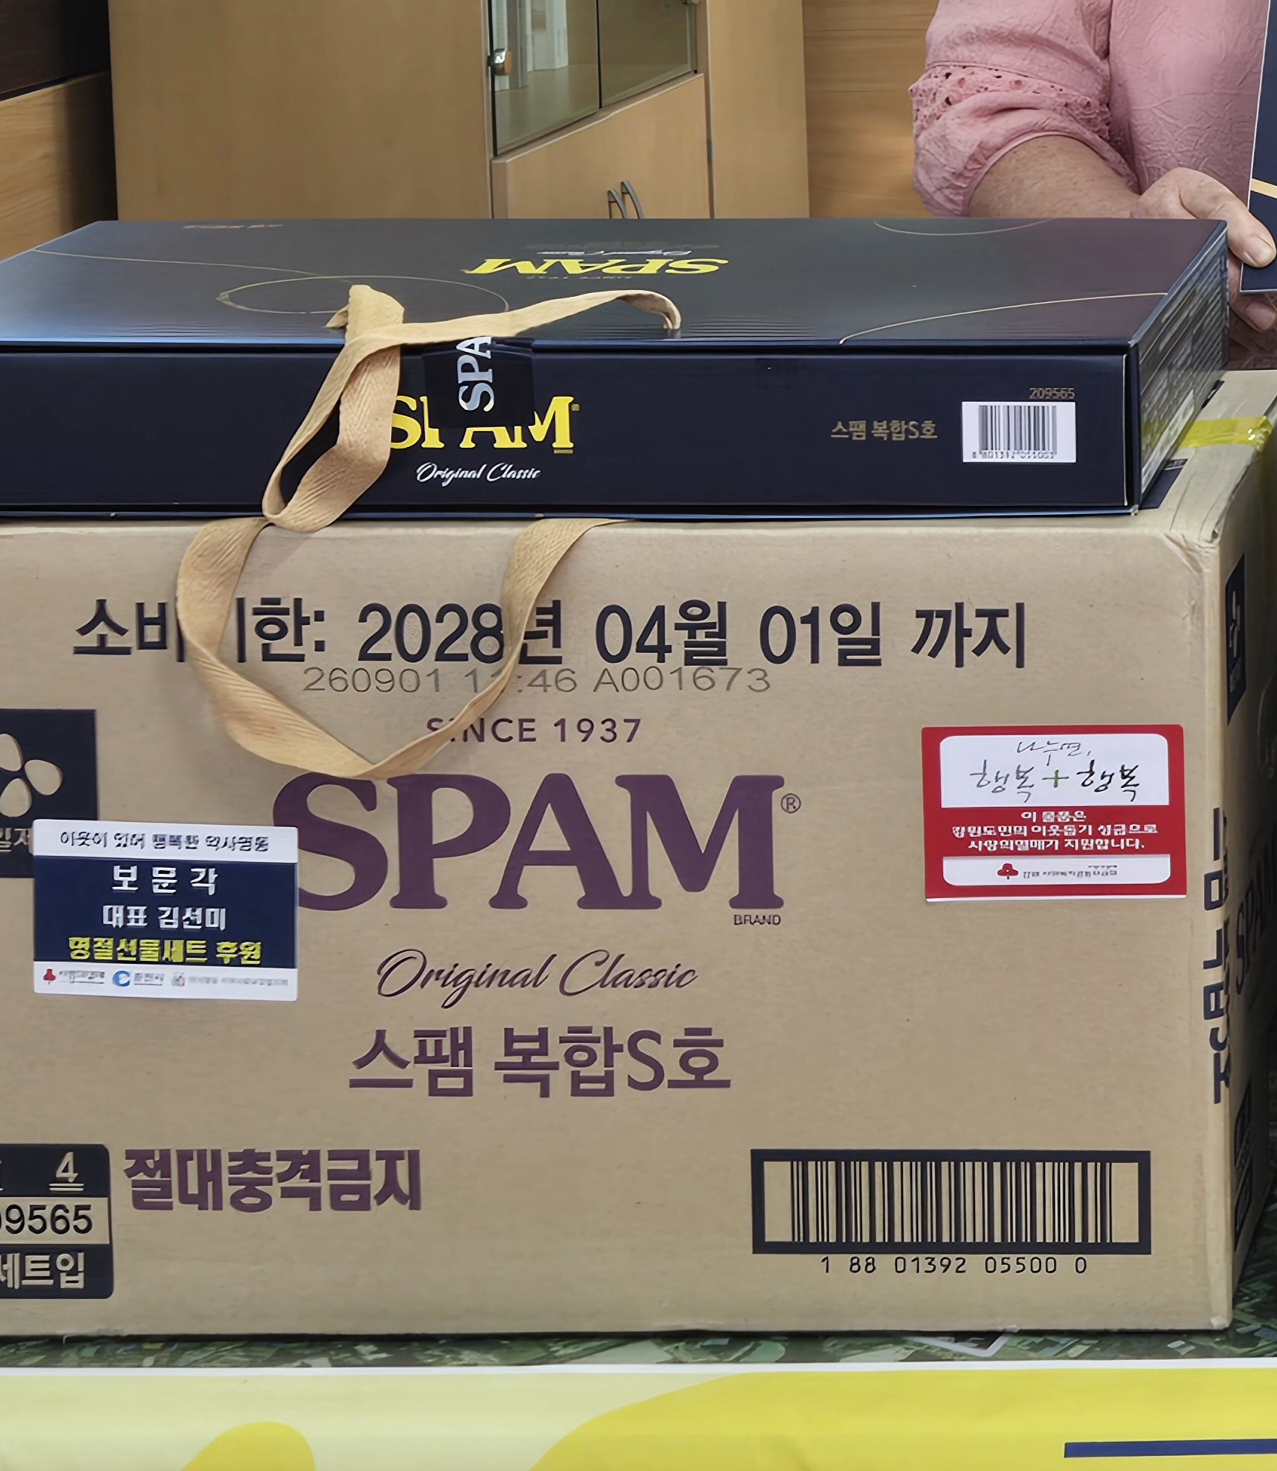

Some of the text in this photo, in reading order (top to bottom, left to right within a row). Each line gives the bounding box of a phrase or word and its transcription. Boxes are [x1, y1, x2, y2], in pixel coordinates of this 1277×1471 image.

[830, 419, 939, 442] 스팸 복합S호
[415, 461, 542, 487] Original Classic
[357, 598, 564, 665] 2028년
[595, 599, 732, 667] 04월
[758, 601, 883, 668] 01일
[912, 598, 1029, 669] 까지
[302, 666, 443, 693] 260901
[592, 666, 774, 693] A001673
[426, 717, 642, 743] SNCE 1937
[60, 831, 108, 849] 이웃이
[113, 832, 146, 849] 있어
[271, 773, 785, 913] SPAM
[102, 905, 227, 931] 대표 김선미
[732, 913, 783, 926] BRAND
[67, 936, 263, 965] 명절선물세트 후원
[375, 945, 699, 1011] Original Classic
[347, 1024, 733, 1100] 스팸 복합S호
[56, 1151, 79, 1183] 4
[123, 1147, 422, 1213] 절대충격금지
[820, 1256, 1088, 1275] 1 88 01392 05500 0
